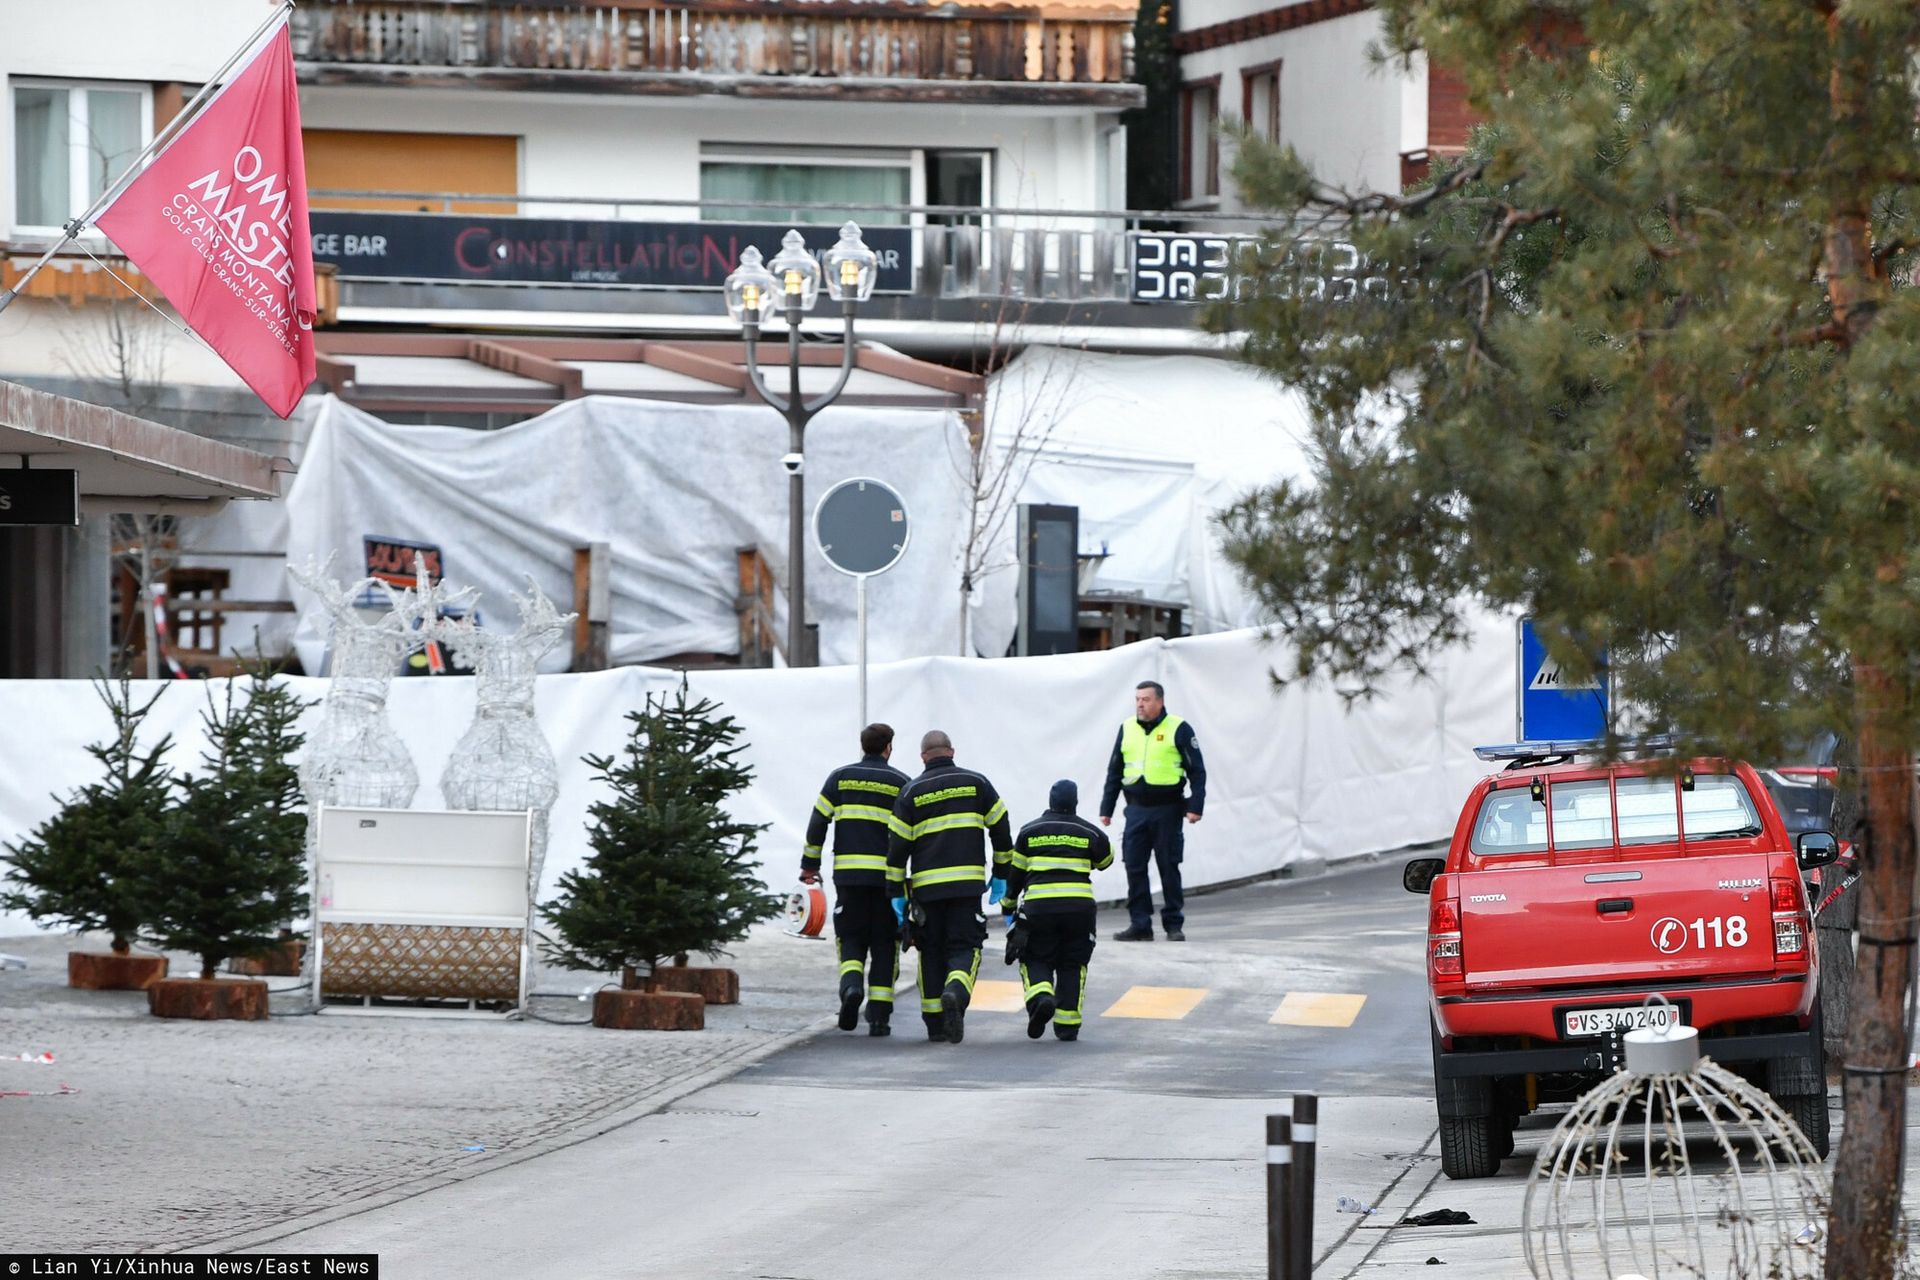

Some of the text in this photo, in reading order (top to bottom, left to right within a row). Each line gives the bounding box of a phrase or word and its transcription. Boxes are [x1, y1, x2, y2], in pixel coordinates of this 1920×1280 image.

[162, 206, 192, 236] GOLF
[191, 236, 214, 264] CLUB
[344, 235, 387, 257] BAR
[173, 193, 291, 330] CRANS MONTANA
[1718, 878, 1762, 889] HILUX
[1470, 893, 1507, 903] TOYOTA
[1690, 915, 1748, 949] 118
